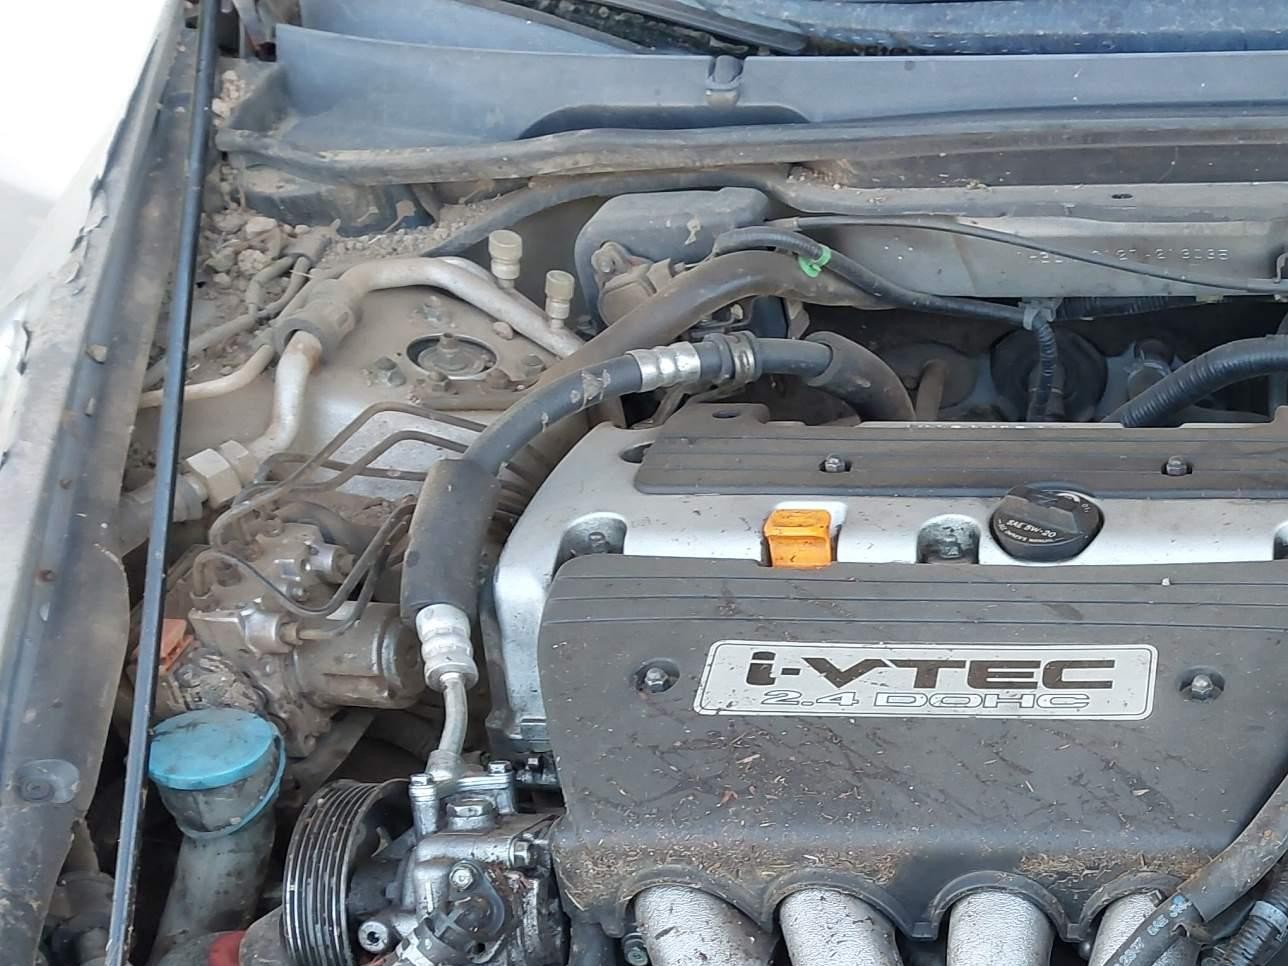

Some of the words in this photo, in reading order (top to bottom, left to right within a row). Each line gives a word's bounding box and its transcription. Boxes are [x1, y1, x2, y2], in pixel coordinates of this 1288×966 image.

[1006, 519, 1024, 530] SAE
[746, 651, 1114, 690] i-VTEC
[760, 690, 859, 707] 2.4
[874, 692, 1090, 710] DOHC
